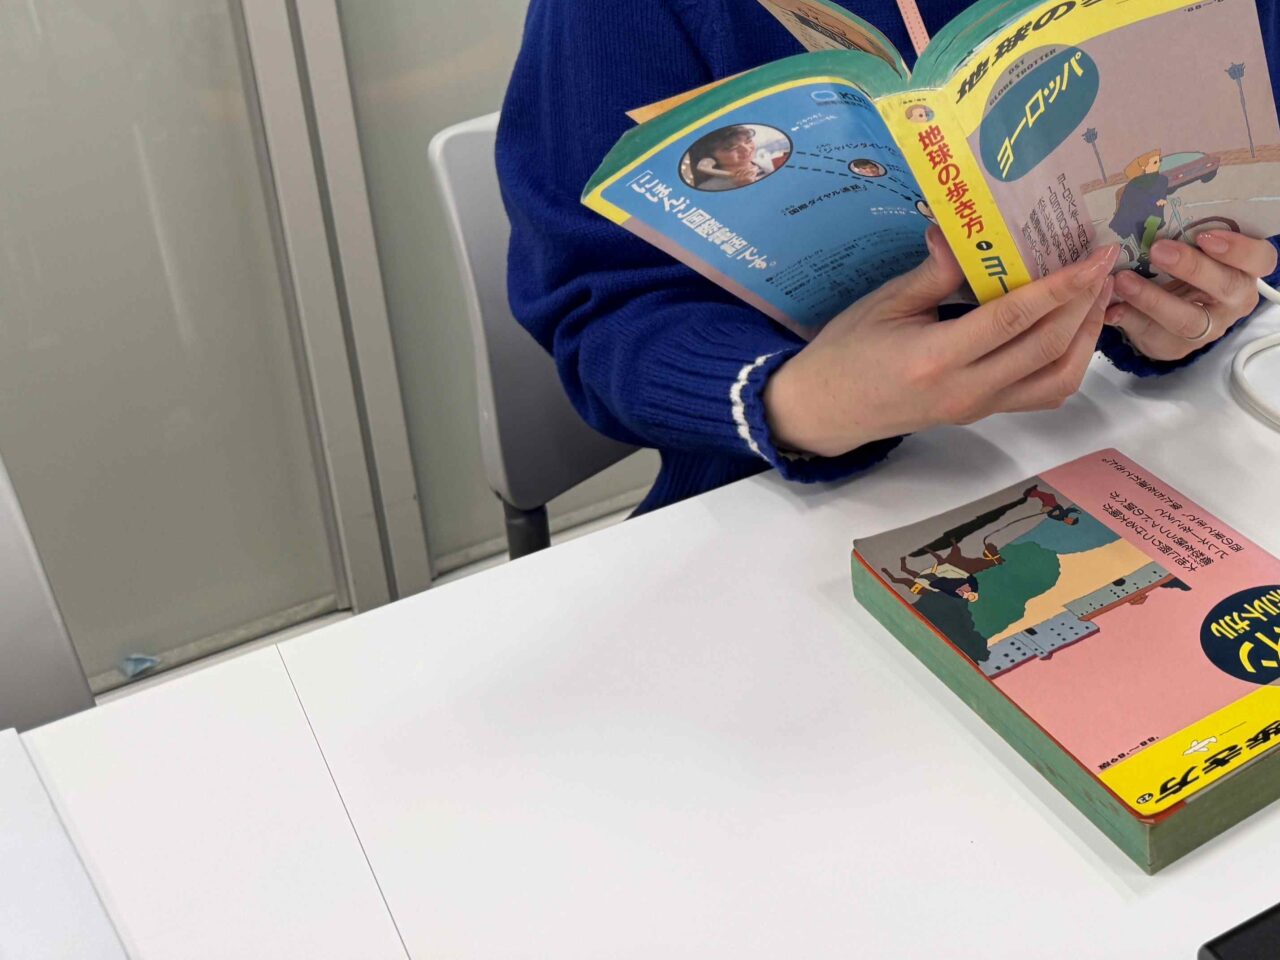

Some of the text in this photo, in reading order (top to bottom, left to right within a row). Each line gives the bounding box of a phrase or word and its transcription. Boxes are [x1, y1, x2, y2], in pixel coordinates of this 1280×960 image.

[1008, 58, 1025, 75] DST
[1016, 48, 1057, 79] TROTTER
[997, 51, 1084, 179] ヨーロッパ
[918, 124, 985, 239] 地球の歩き方
[1155, 508, 1229, 559] ピレネーをこえて
